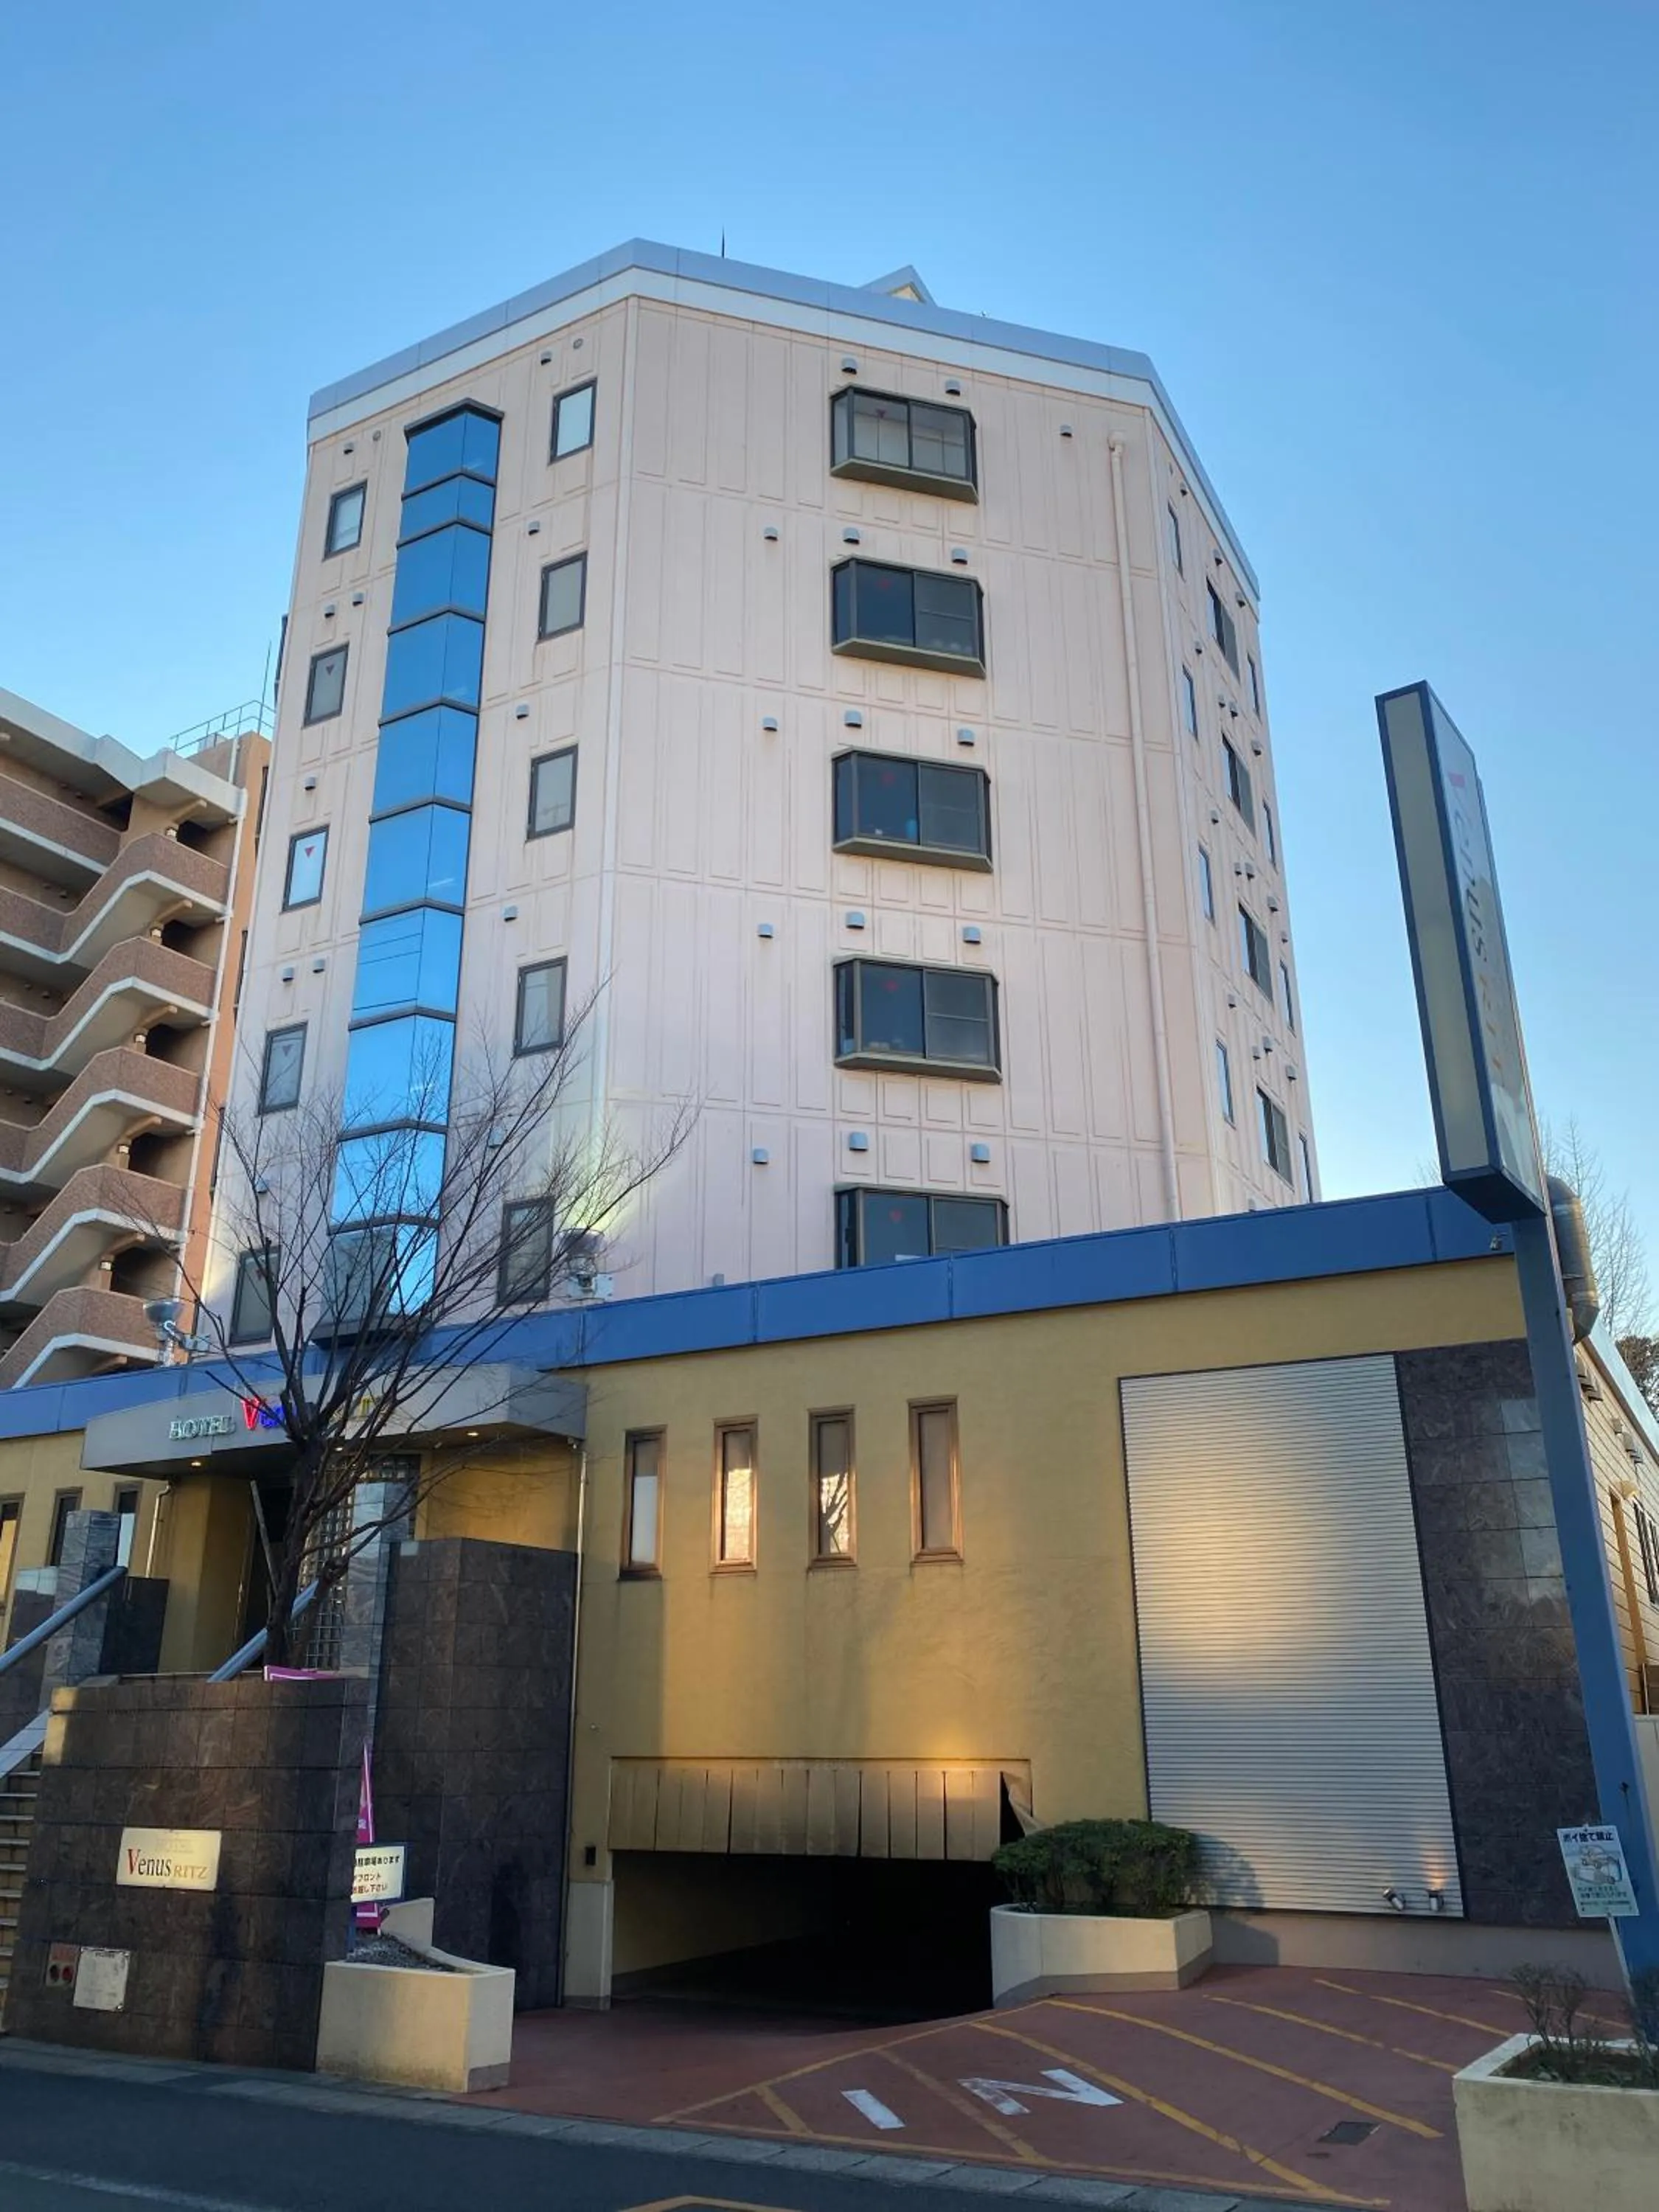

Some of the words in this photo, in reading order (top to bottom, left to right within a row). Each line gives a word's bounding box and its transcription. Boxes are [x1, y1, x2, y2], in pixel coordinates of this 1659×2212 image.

[169, 1415, 234, 1440] HOTEL
[128, 1848, 172, 1877] Venus
[173, 1865, 207, 1879] RITZ
[354, 1855, 400, 1867] 駐車場あります
[354, 1873, 381, 1882] フロント
[841, 2069, 1124, 2129] IN
